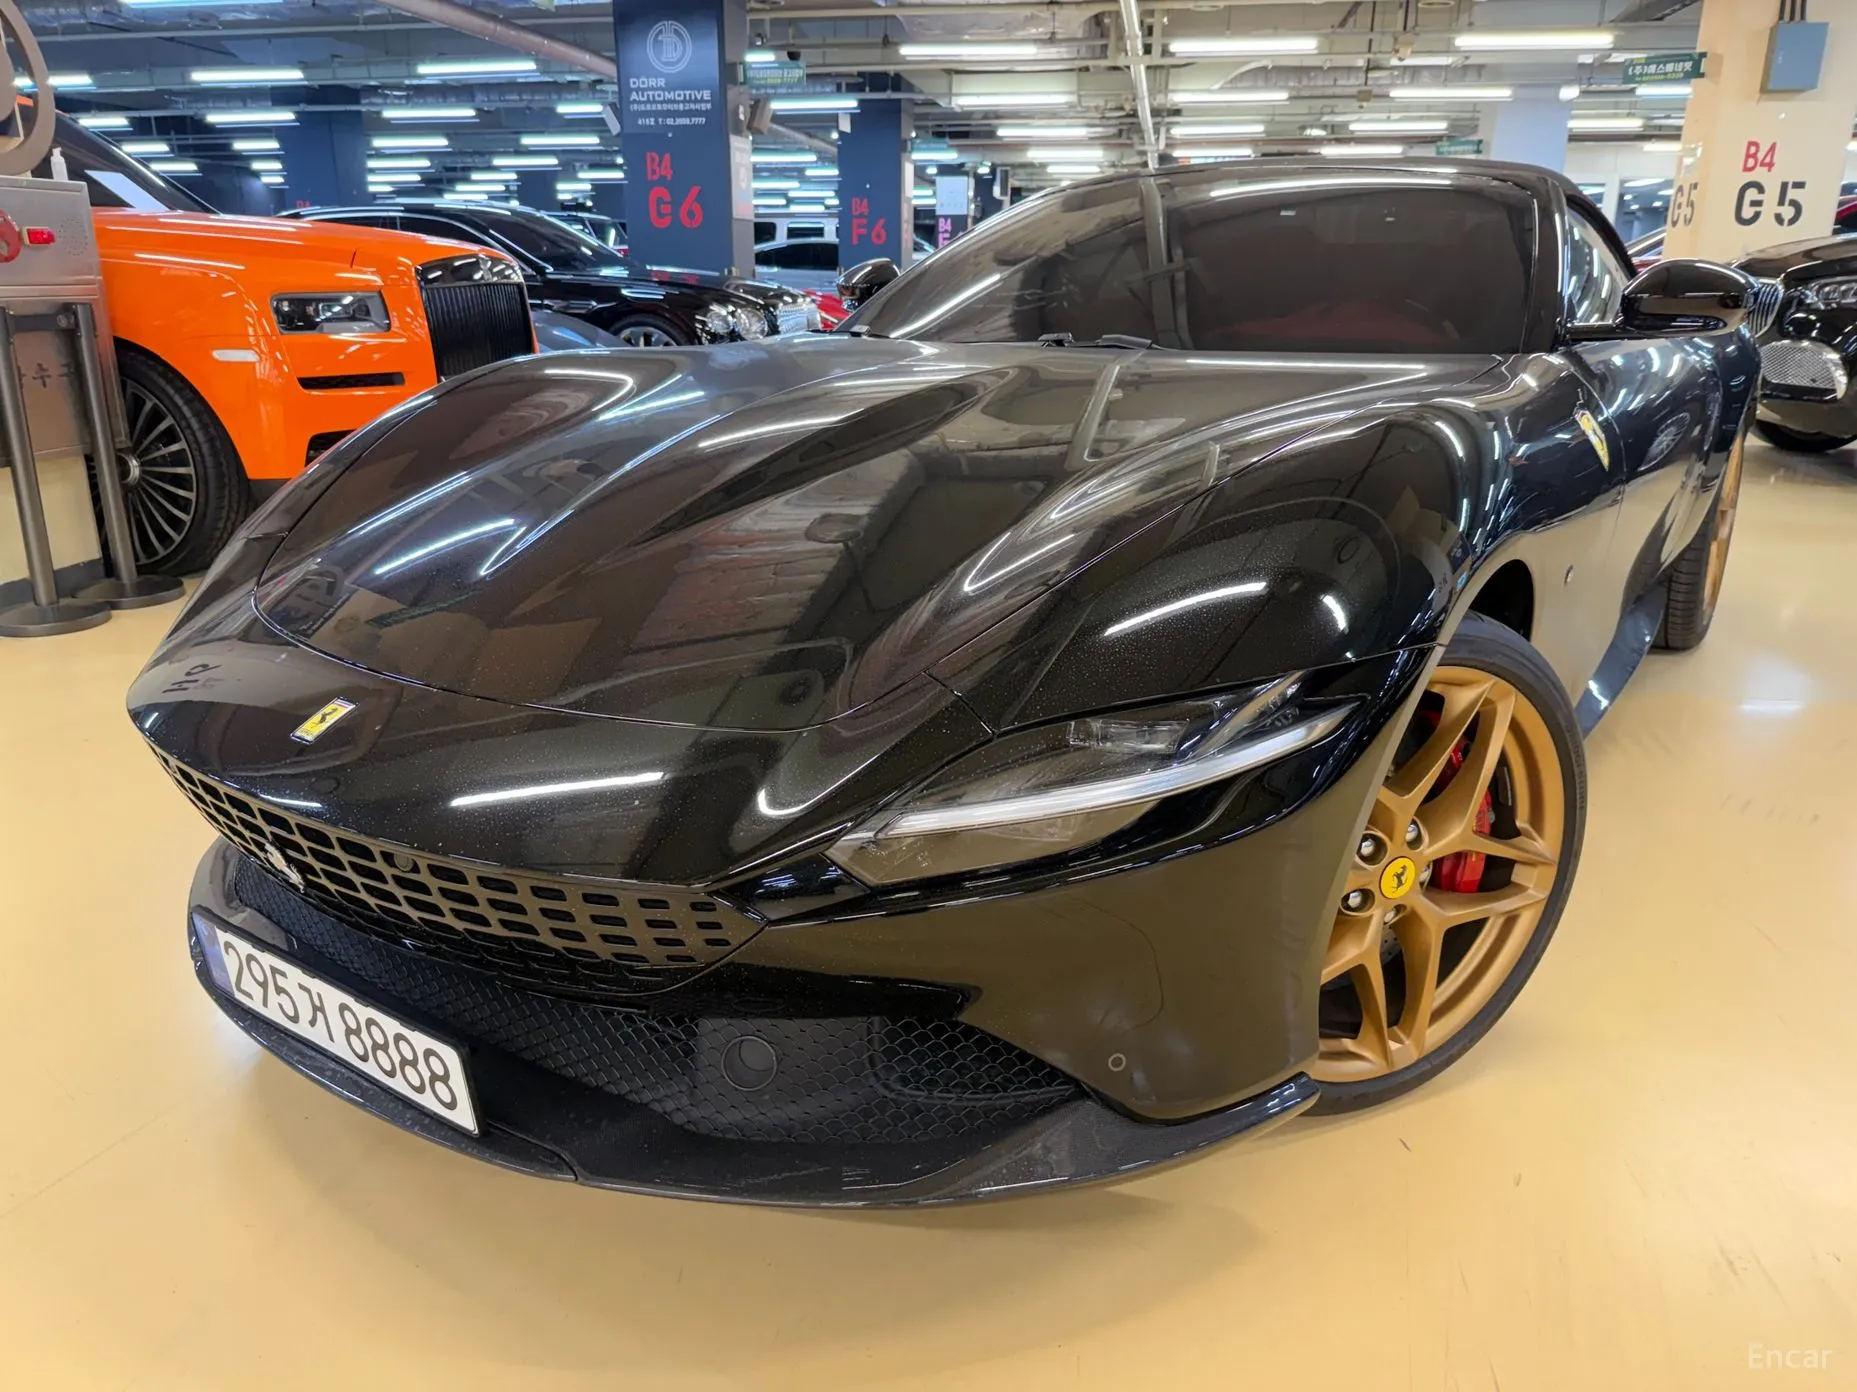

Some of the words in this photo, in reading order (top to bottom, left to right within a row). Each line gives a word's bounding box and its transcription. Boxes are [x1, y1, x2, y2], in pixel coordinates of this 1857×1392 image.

[630, 90, 712, 101] AUTOMOTIVE
[1742, 140, 1777, 173] B4
[646, 152, 673, 181] B4
[852, 197, 869, 215] B4
[938, 217, 952, 233] B4
